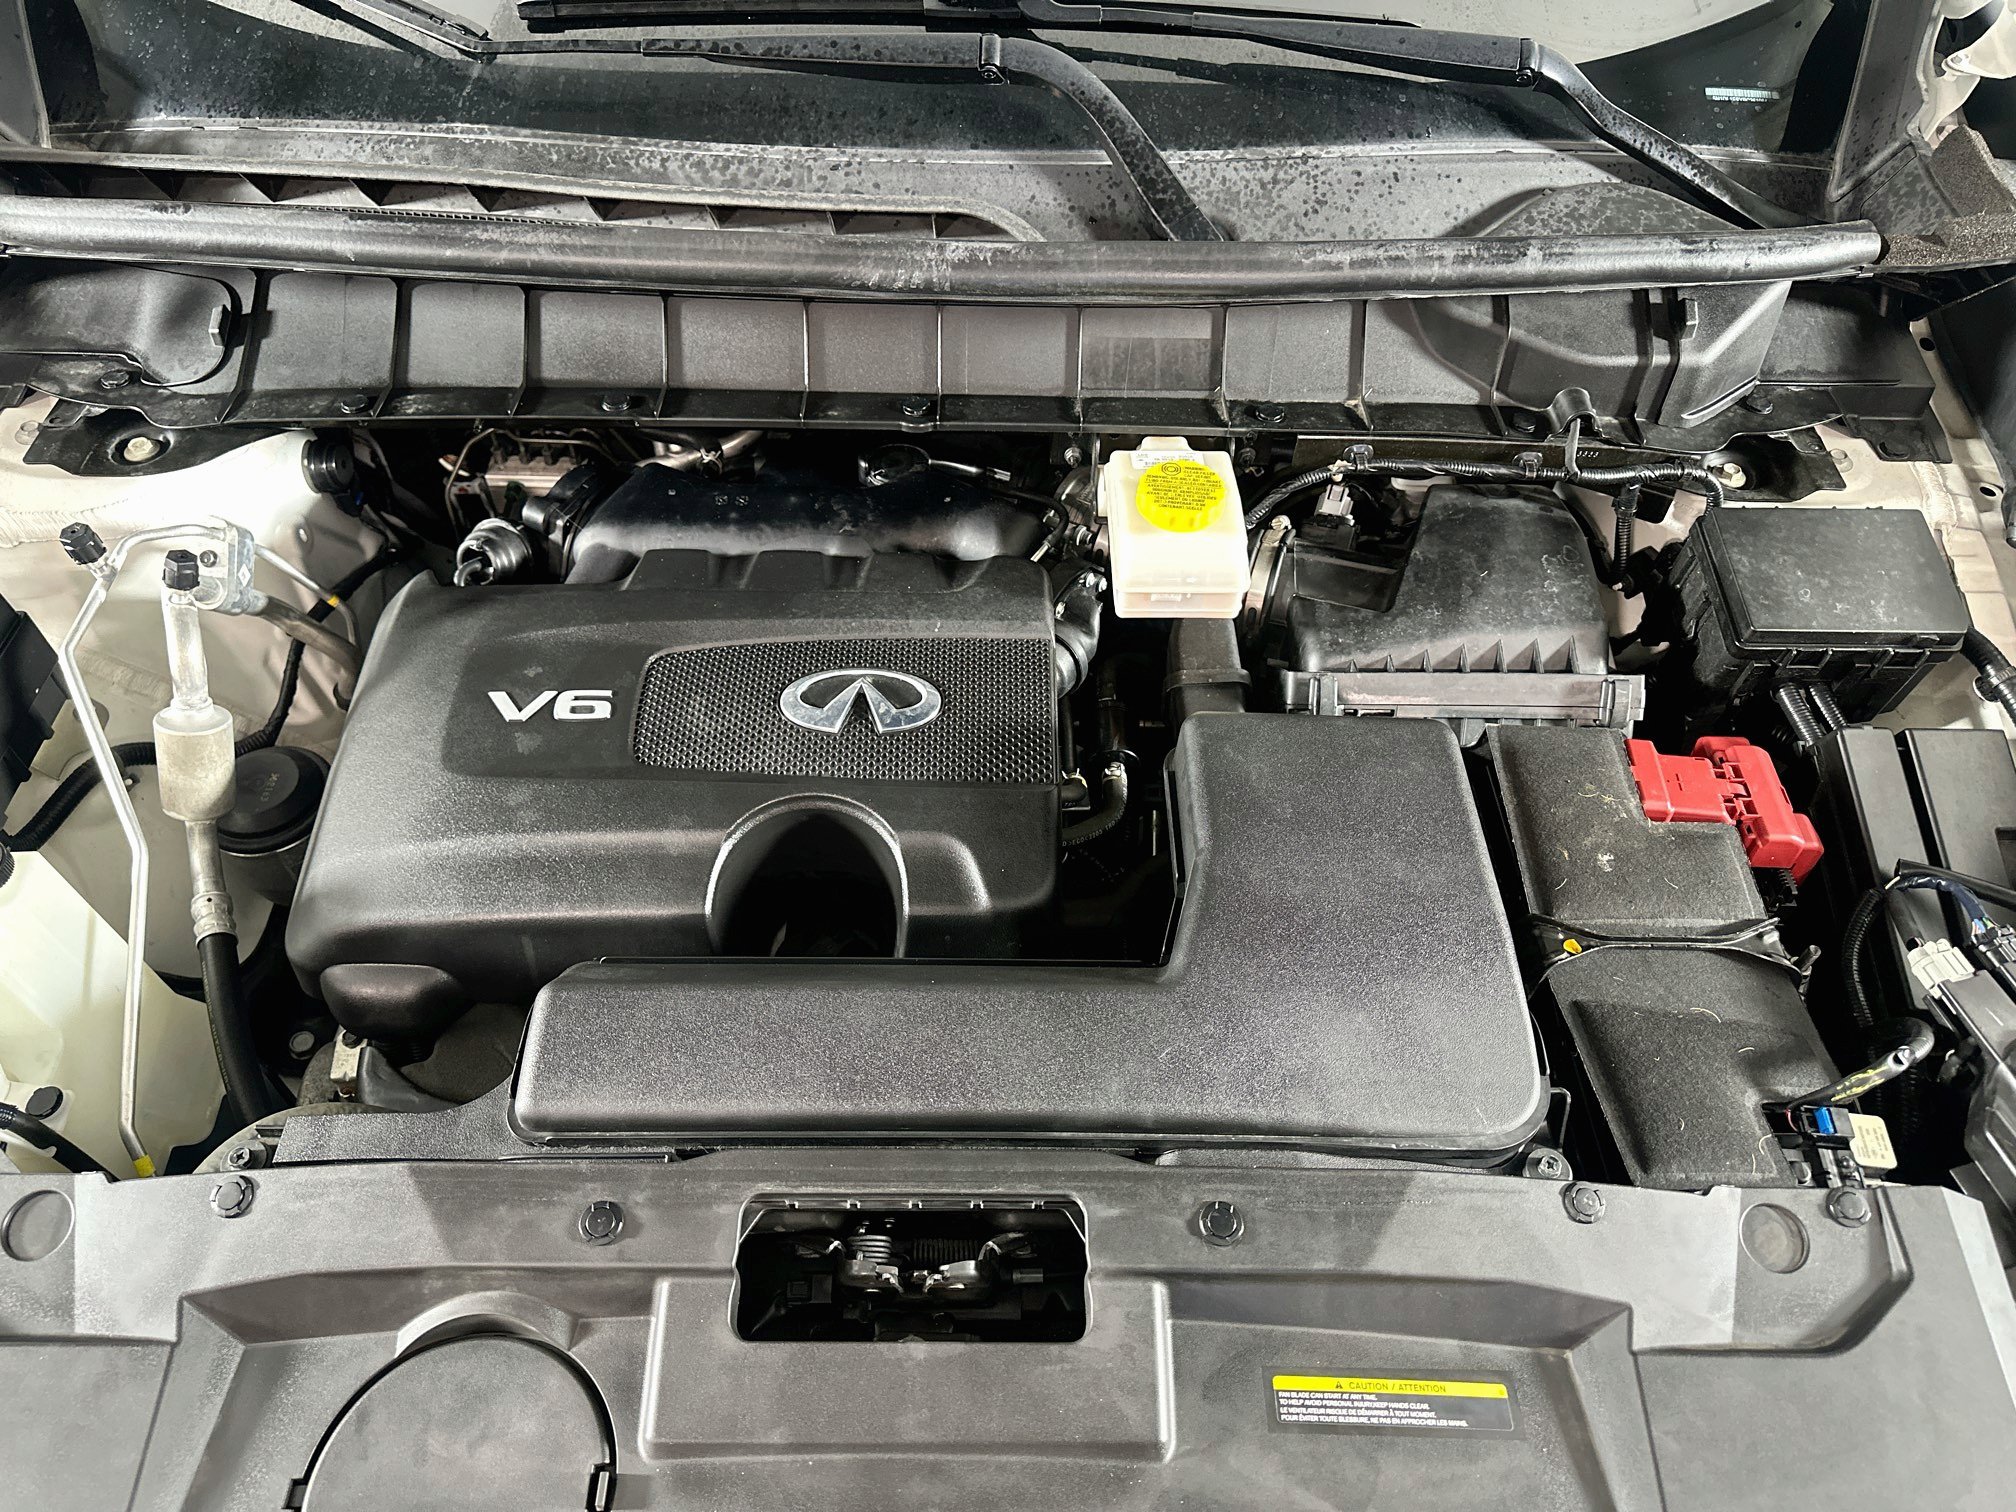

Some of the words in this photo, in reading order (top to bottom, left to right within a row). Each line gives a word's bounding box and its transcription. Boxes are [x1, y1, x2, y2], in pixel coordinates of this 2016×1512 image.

[487, 689, 613, 721] V6
[1349, 1381, 1389, 1390] CAUTION
[1398, 1383, 1447, 1393] ATTENTION
[1358, 1408, 1389, 1416] DÉMARRER
[1389, 1408, 1394, 1416] À
[1401, 1418, 1436, 1426] APPROCHER
